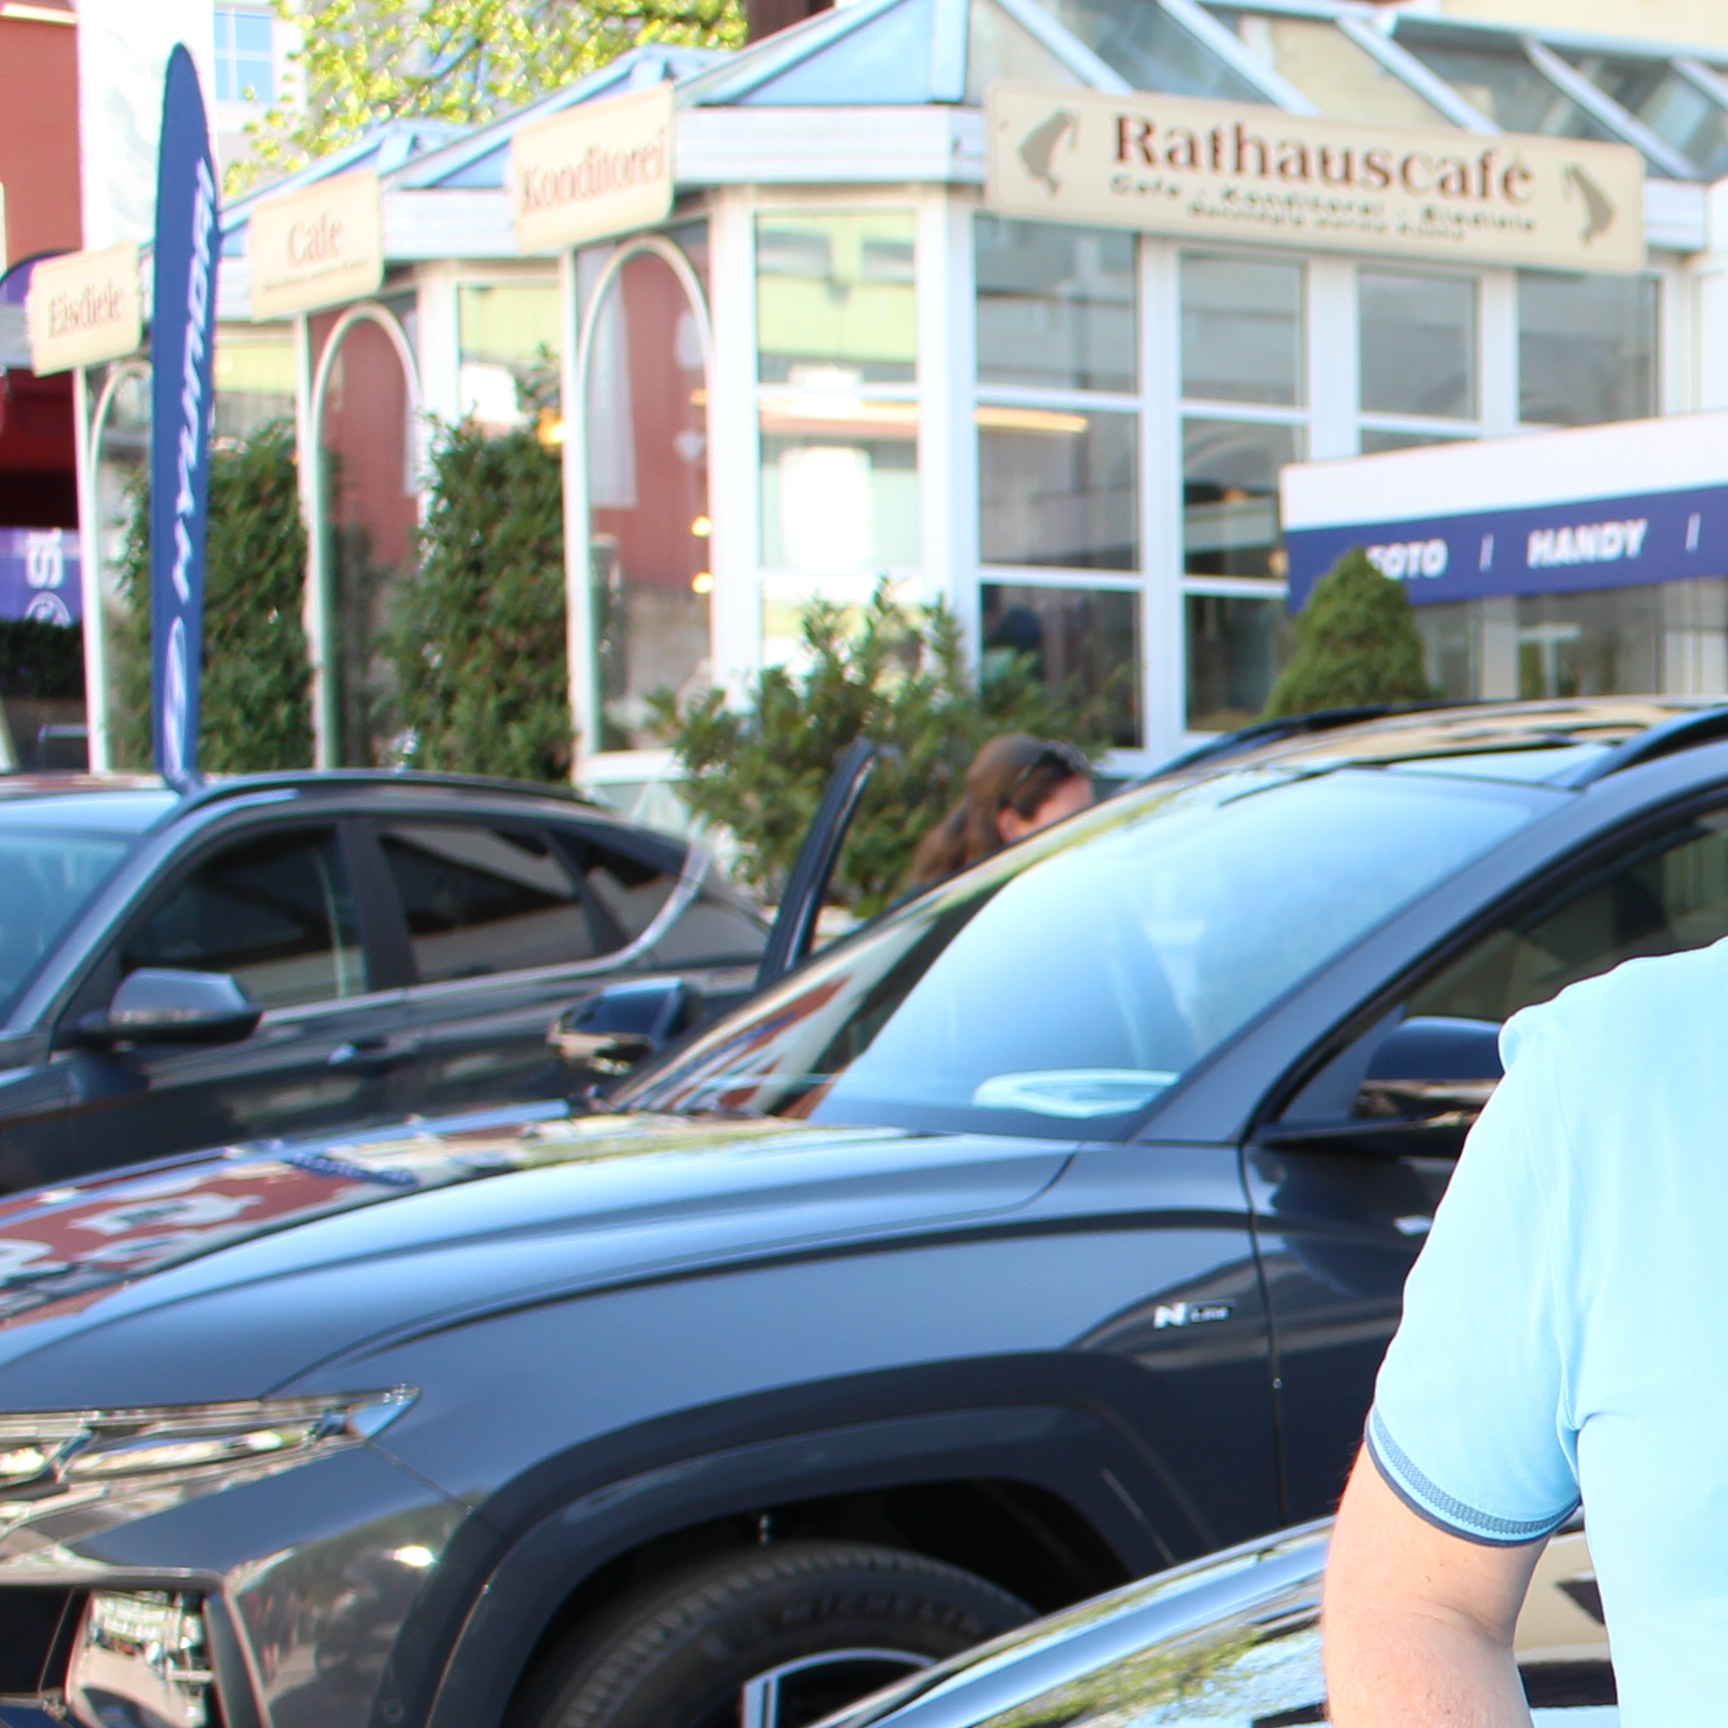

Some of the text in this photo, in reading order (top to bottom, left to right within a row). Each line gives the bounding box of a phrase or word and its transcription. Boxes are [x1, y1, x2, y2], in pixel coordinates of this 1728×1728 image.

[520, 126, 667, 216] Konditorei
[1526, 518, 1649, 569] HANDY
[1152, 1301, 1187, 1330] N
